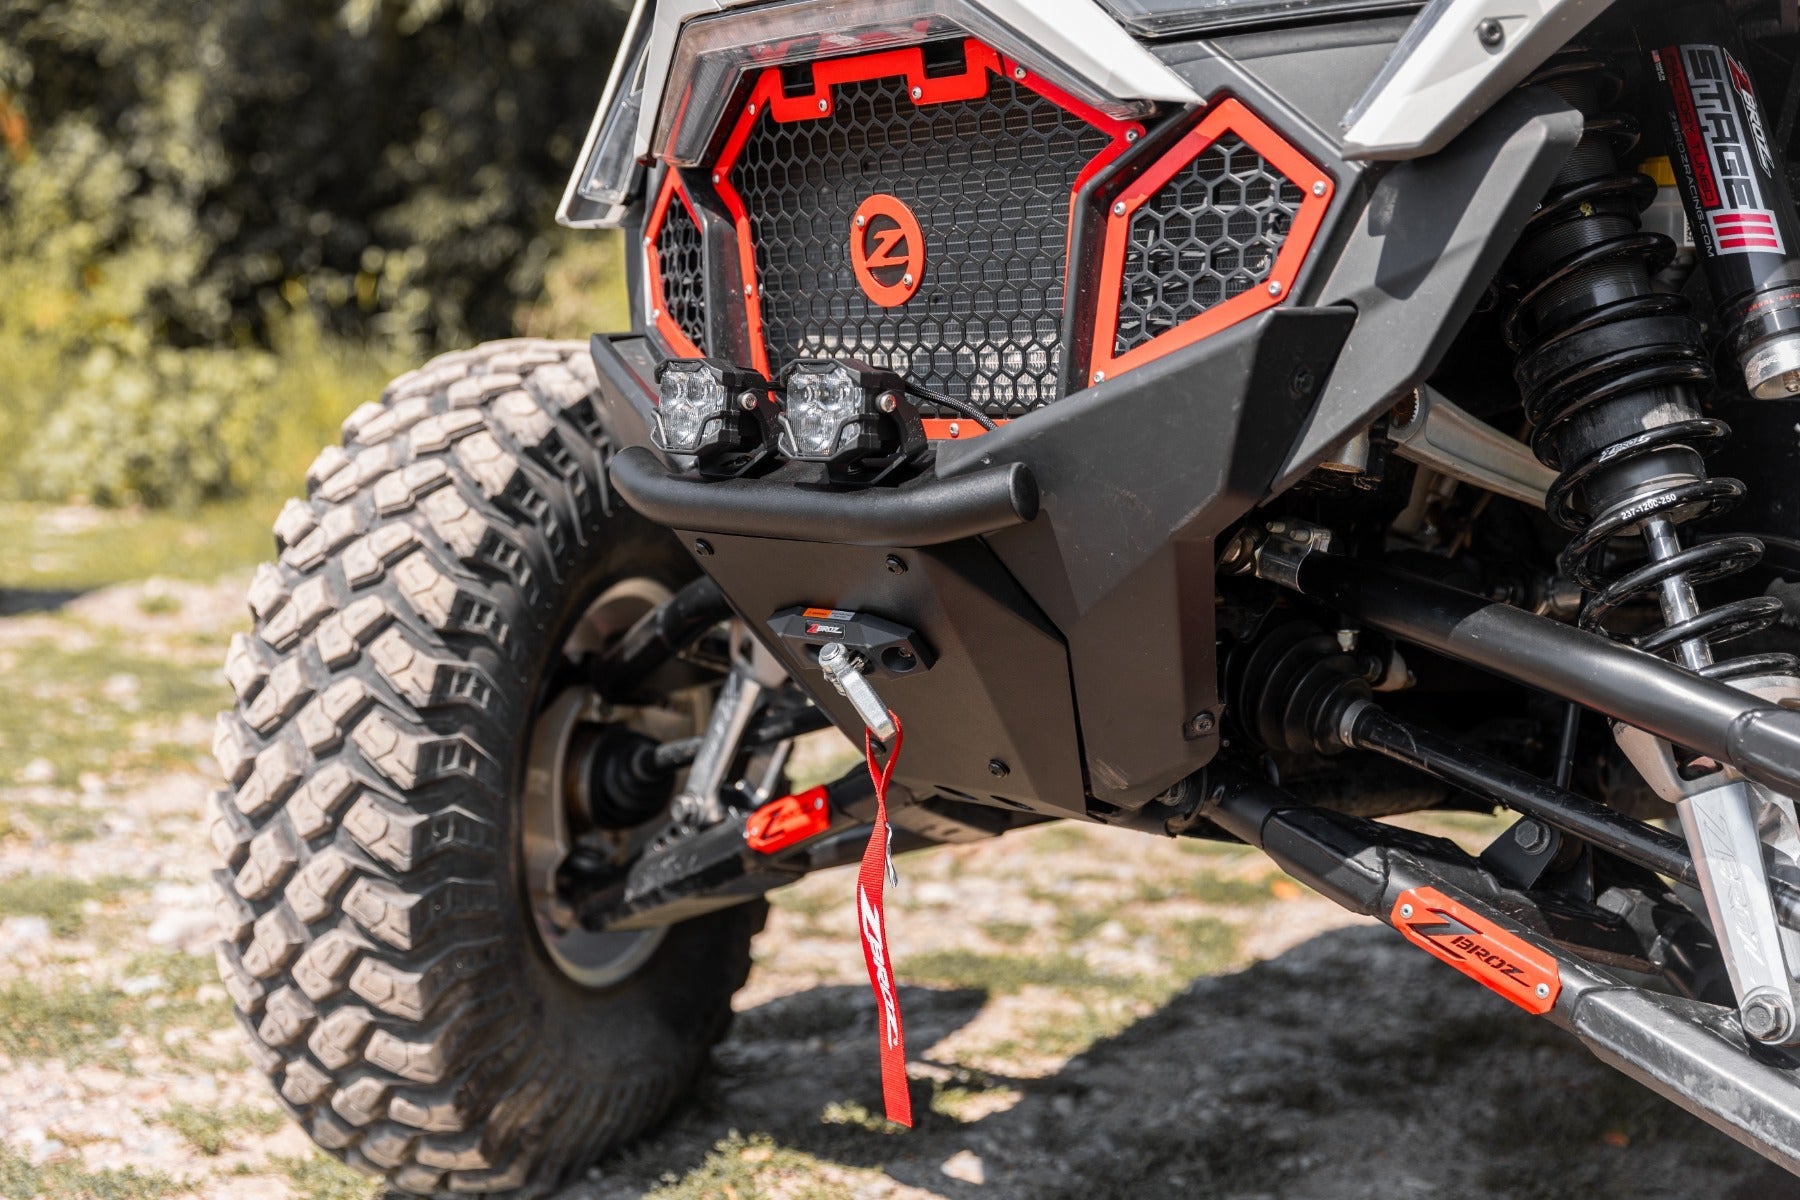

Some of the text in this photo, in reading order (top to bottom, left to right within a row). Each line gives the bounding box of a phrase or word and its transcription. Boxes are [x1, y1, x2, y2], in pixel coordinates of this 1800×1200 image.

[1667, 55, 1714, 202] FACTORY TUNED
[1668, 110, 1715, 258] ZBROZRACING.COM
[1687, 49, 1759, 210] STAGE
[1724, 48, 1773, 177] ZBROZ
[807, 623, 843, 635] ZBROZ
[860, 883, 899, 1050] ZBROZ
[1406, 907, 1531, 988] ZBROZ
